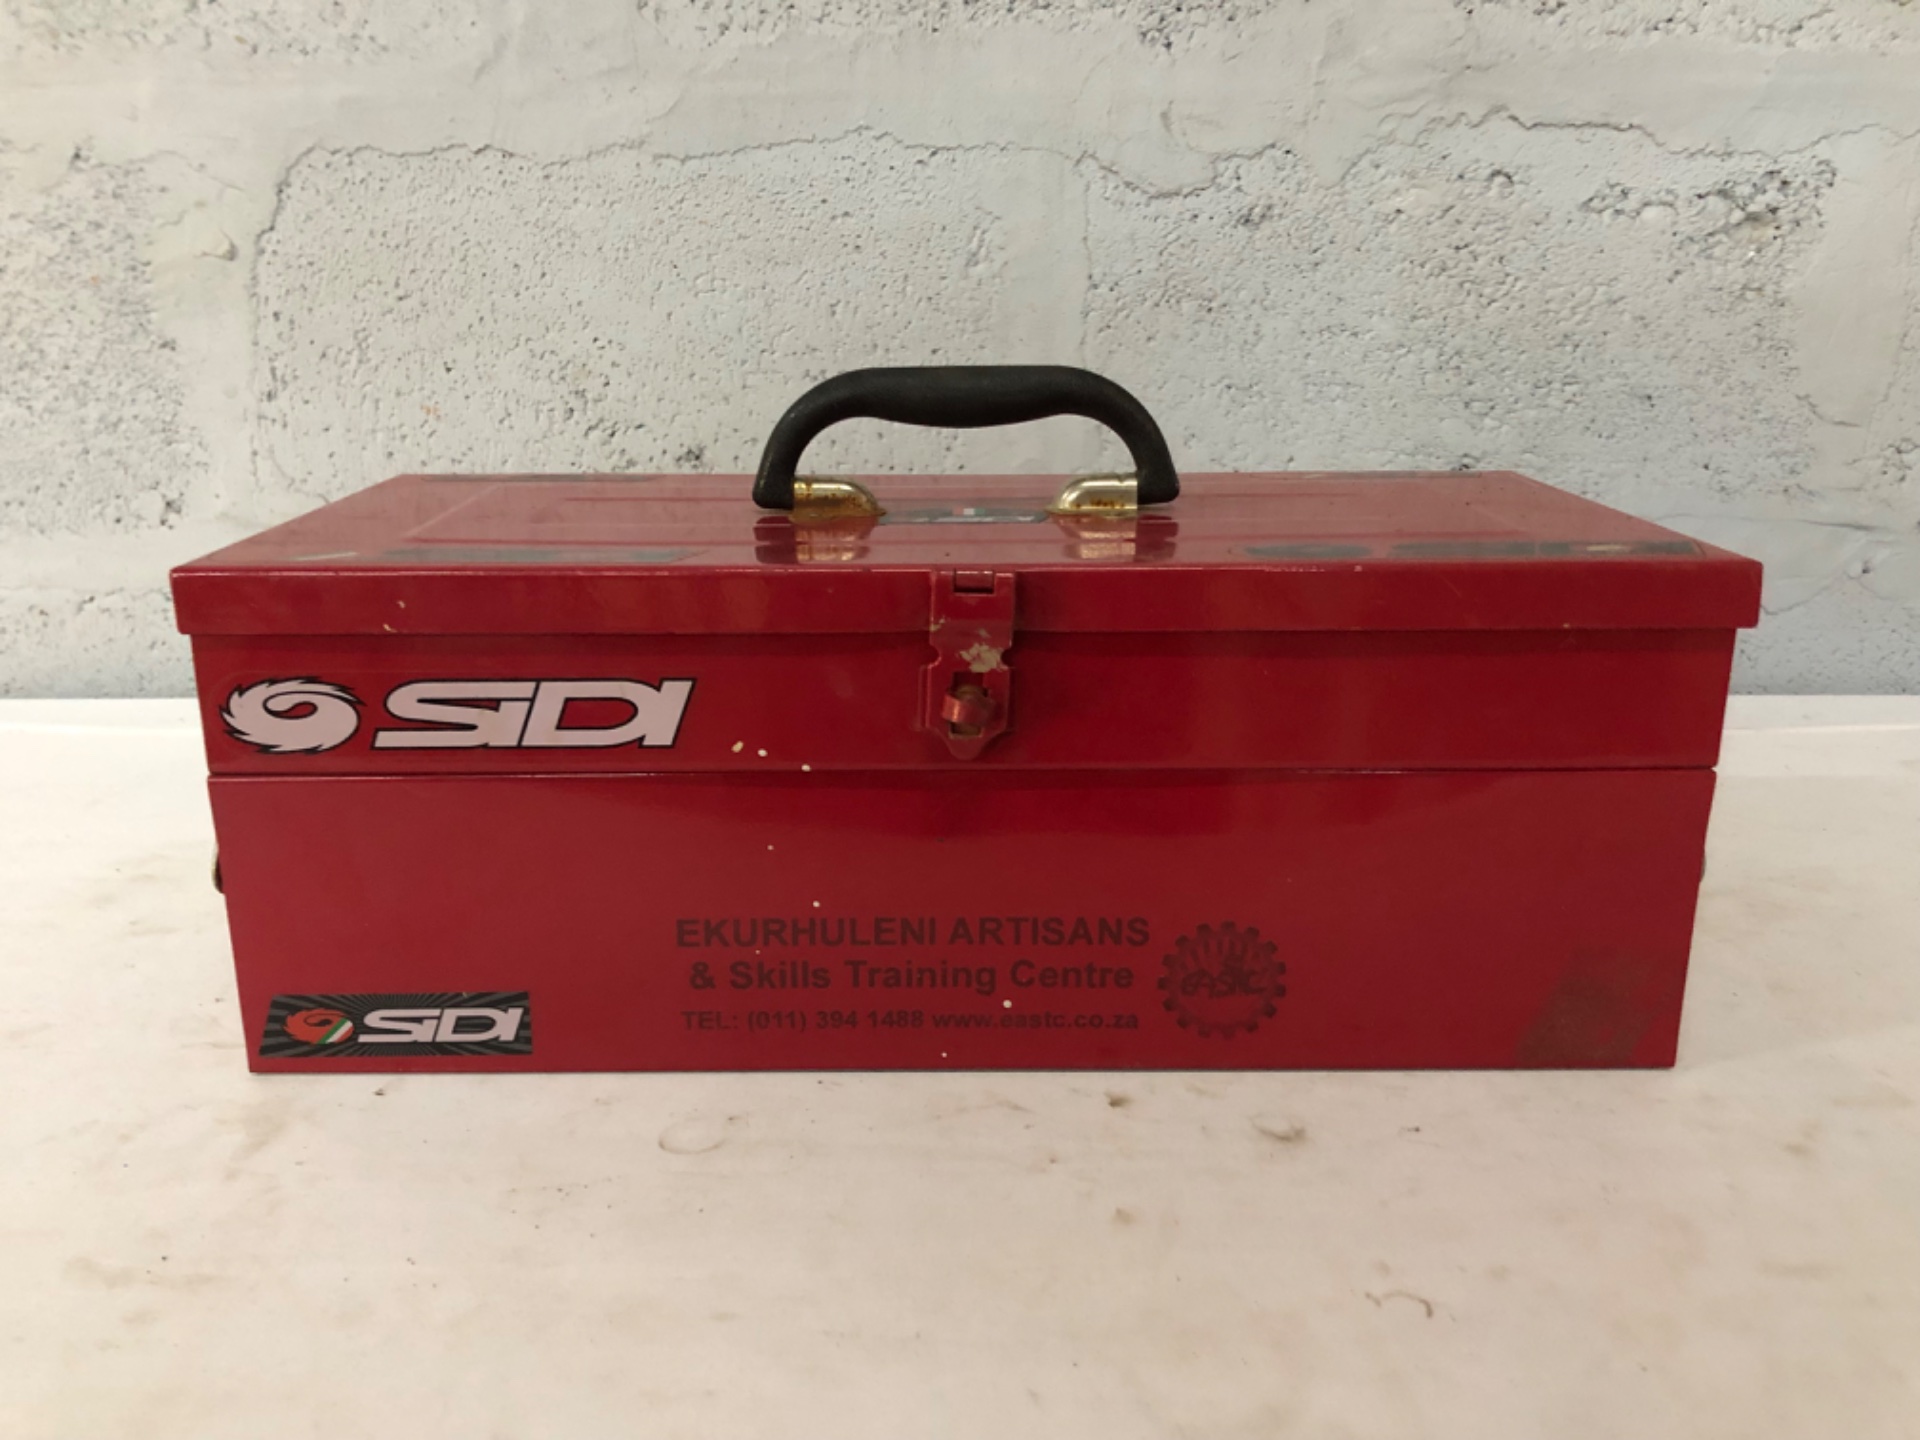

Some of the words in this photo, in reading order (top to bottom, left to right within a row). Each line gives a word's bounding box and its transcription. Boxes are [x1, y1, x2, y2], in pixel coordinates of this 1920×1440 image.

[675, 915, 937, 949] EKURHULENI
[948, 915, 1151, 948] ARTISANS
[688, 960, 716, 990] &
[729, 960, 832, 991] Skills
[843, 959, 997, 996] Training
[1009, 958, 1135, 990] Centre
[680, 1010, 738, 1031] TEL:
[746, 1009, 807, 1033] (011)
[815, 1009, 859, 1030] 394
[866, 1009, 925, 1030] 1488
[931, 1009, 1140, 1032] www.eastc.co.za
